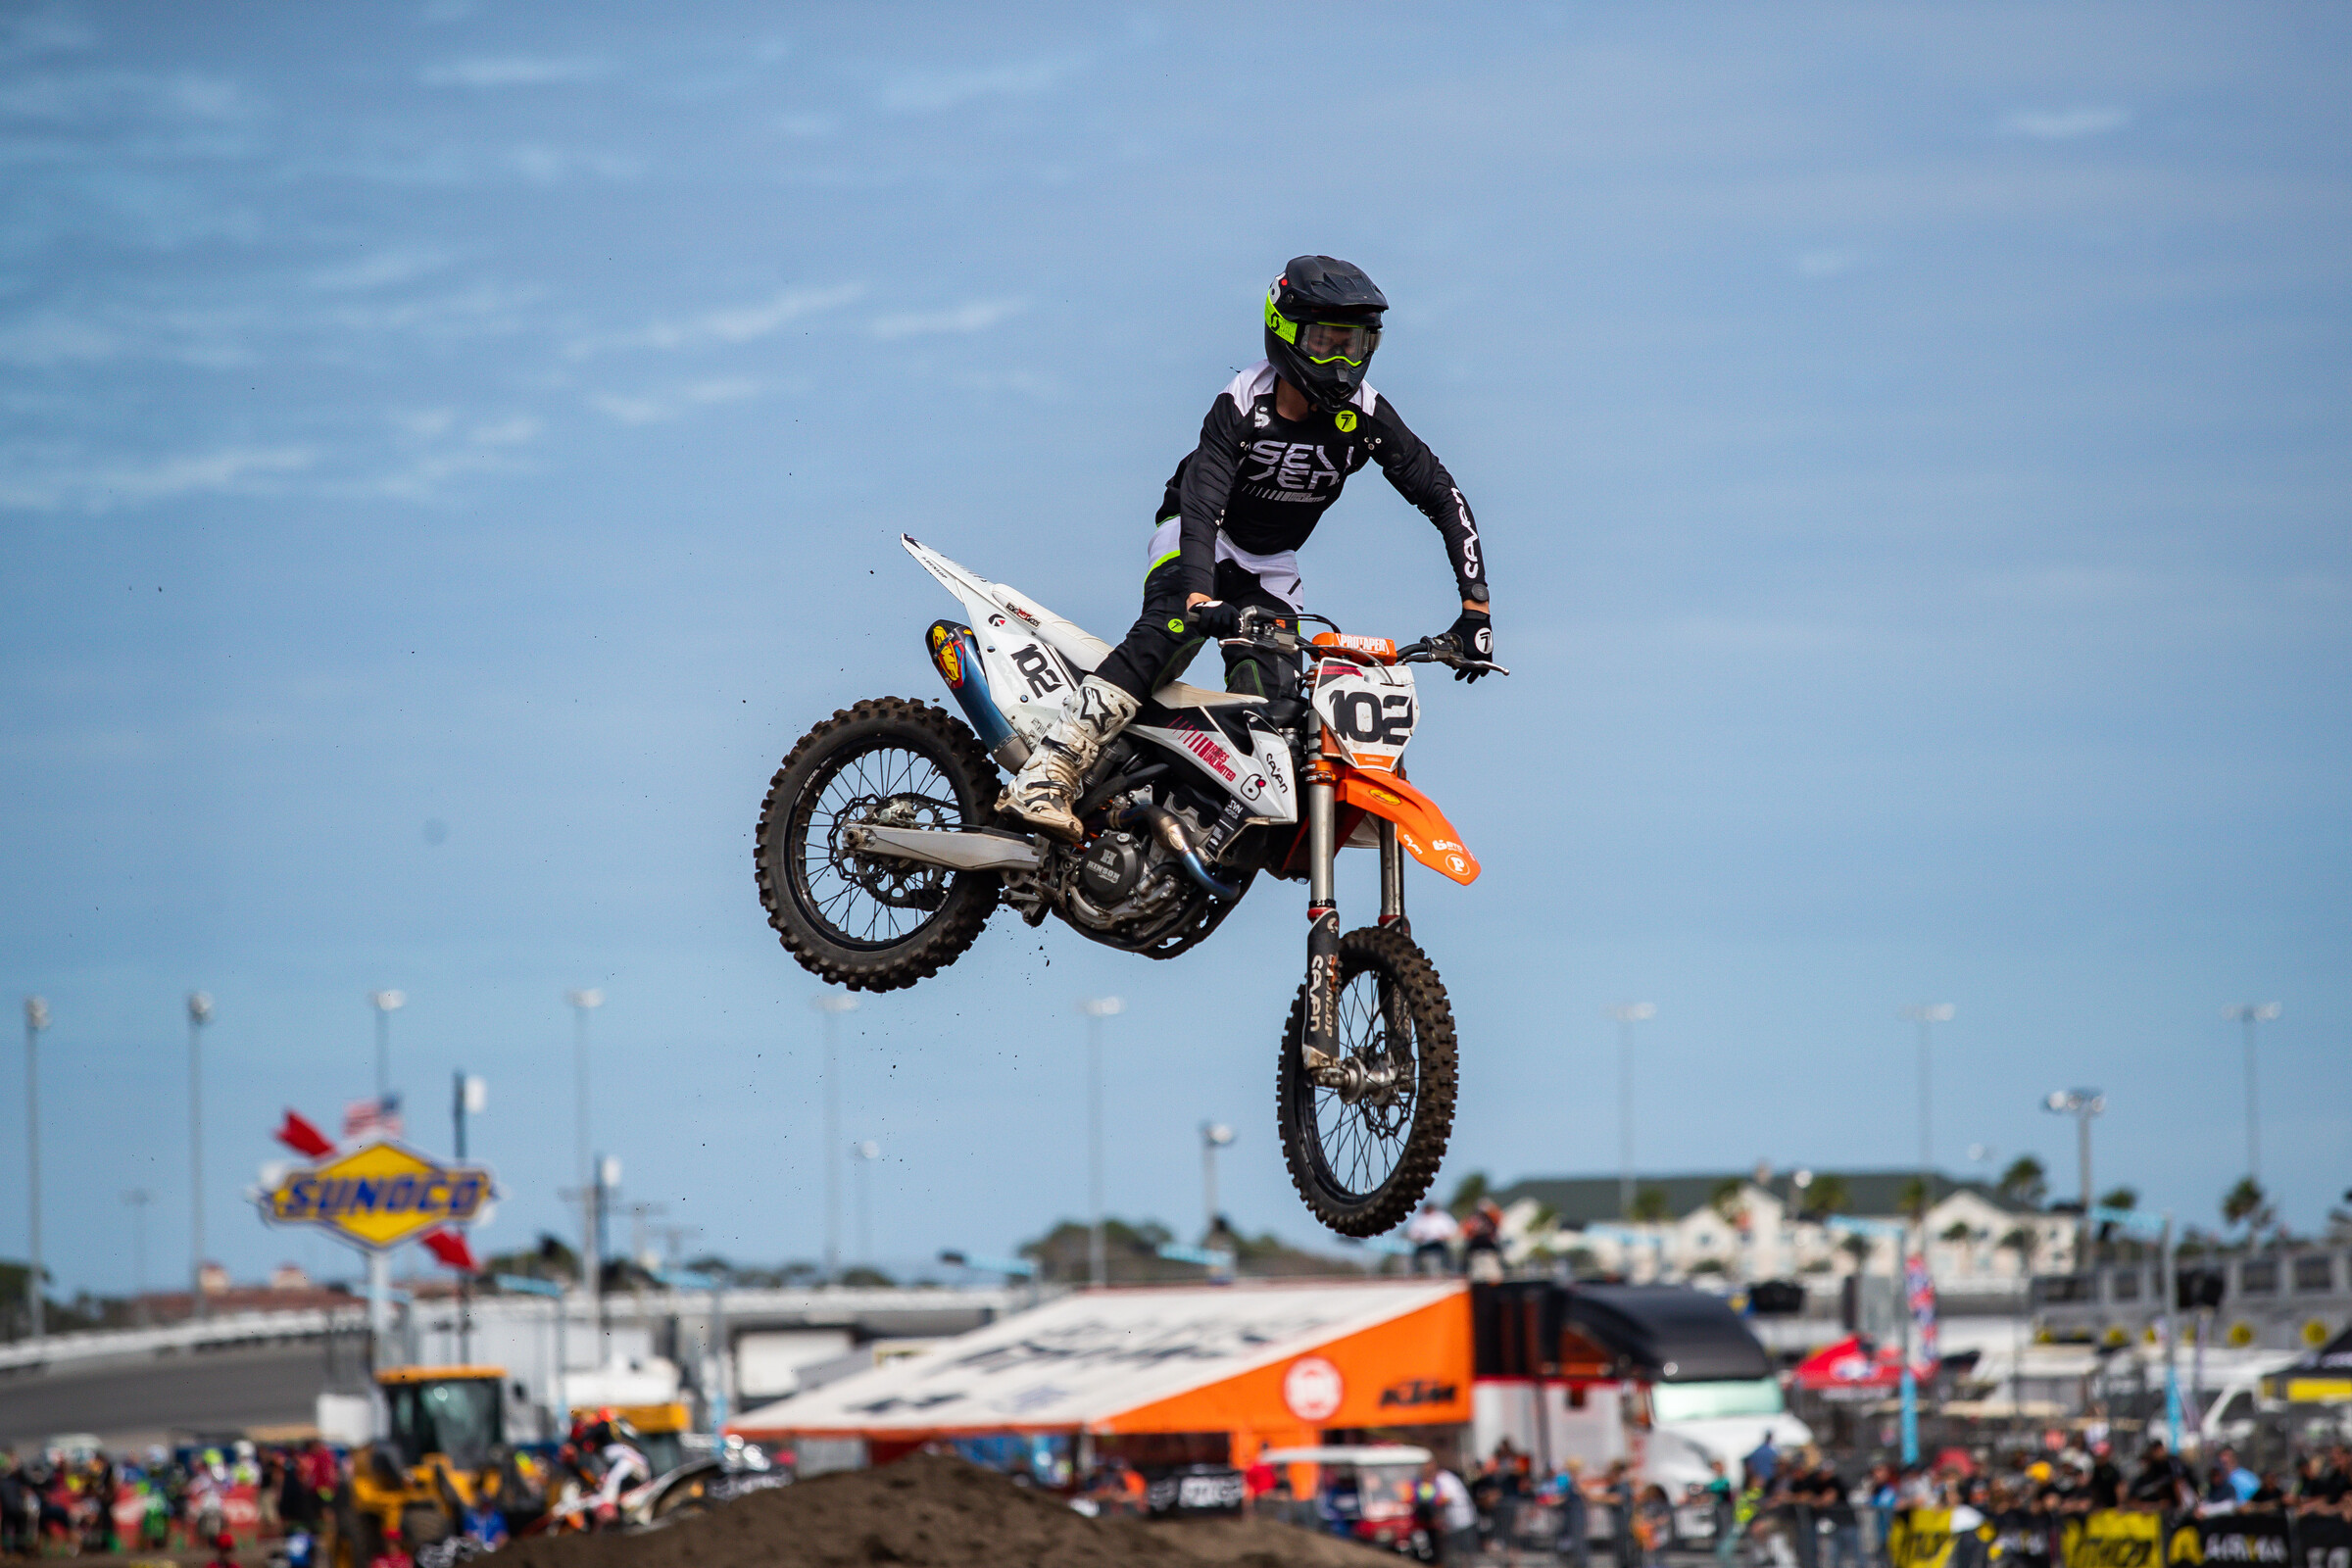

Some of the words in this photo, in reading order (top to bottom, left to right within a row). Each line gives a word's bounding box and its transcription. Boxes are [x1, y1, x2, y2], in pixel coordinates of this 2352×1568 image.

[1339, 634, 1388, 653] PROTAPER
[1010, 643, 1065, 699] 102
[1329, 690, 1413, 746] 102
[1203, 752, 1237, 783] UNLIMITED
[1086, 860, 1120, 881] HINSON
[285, 1175, 482, 1217] SUNOCO
